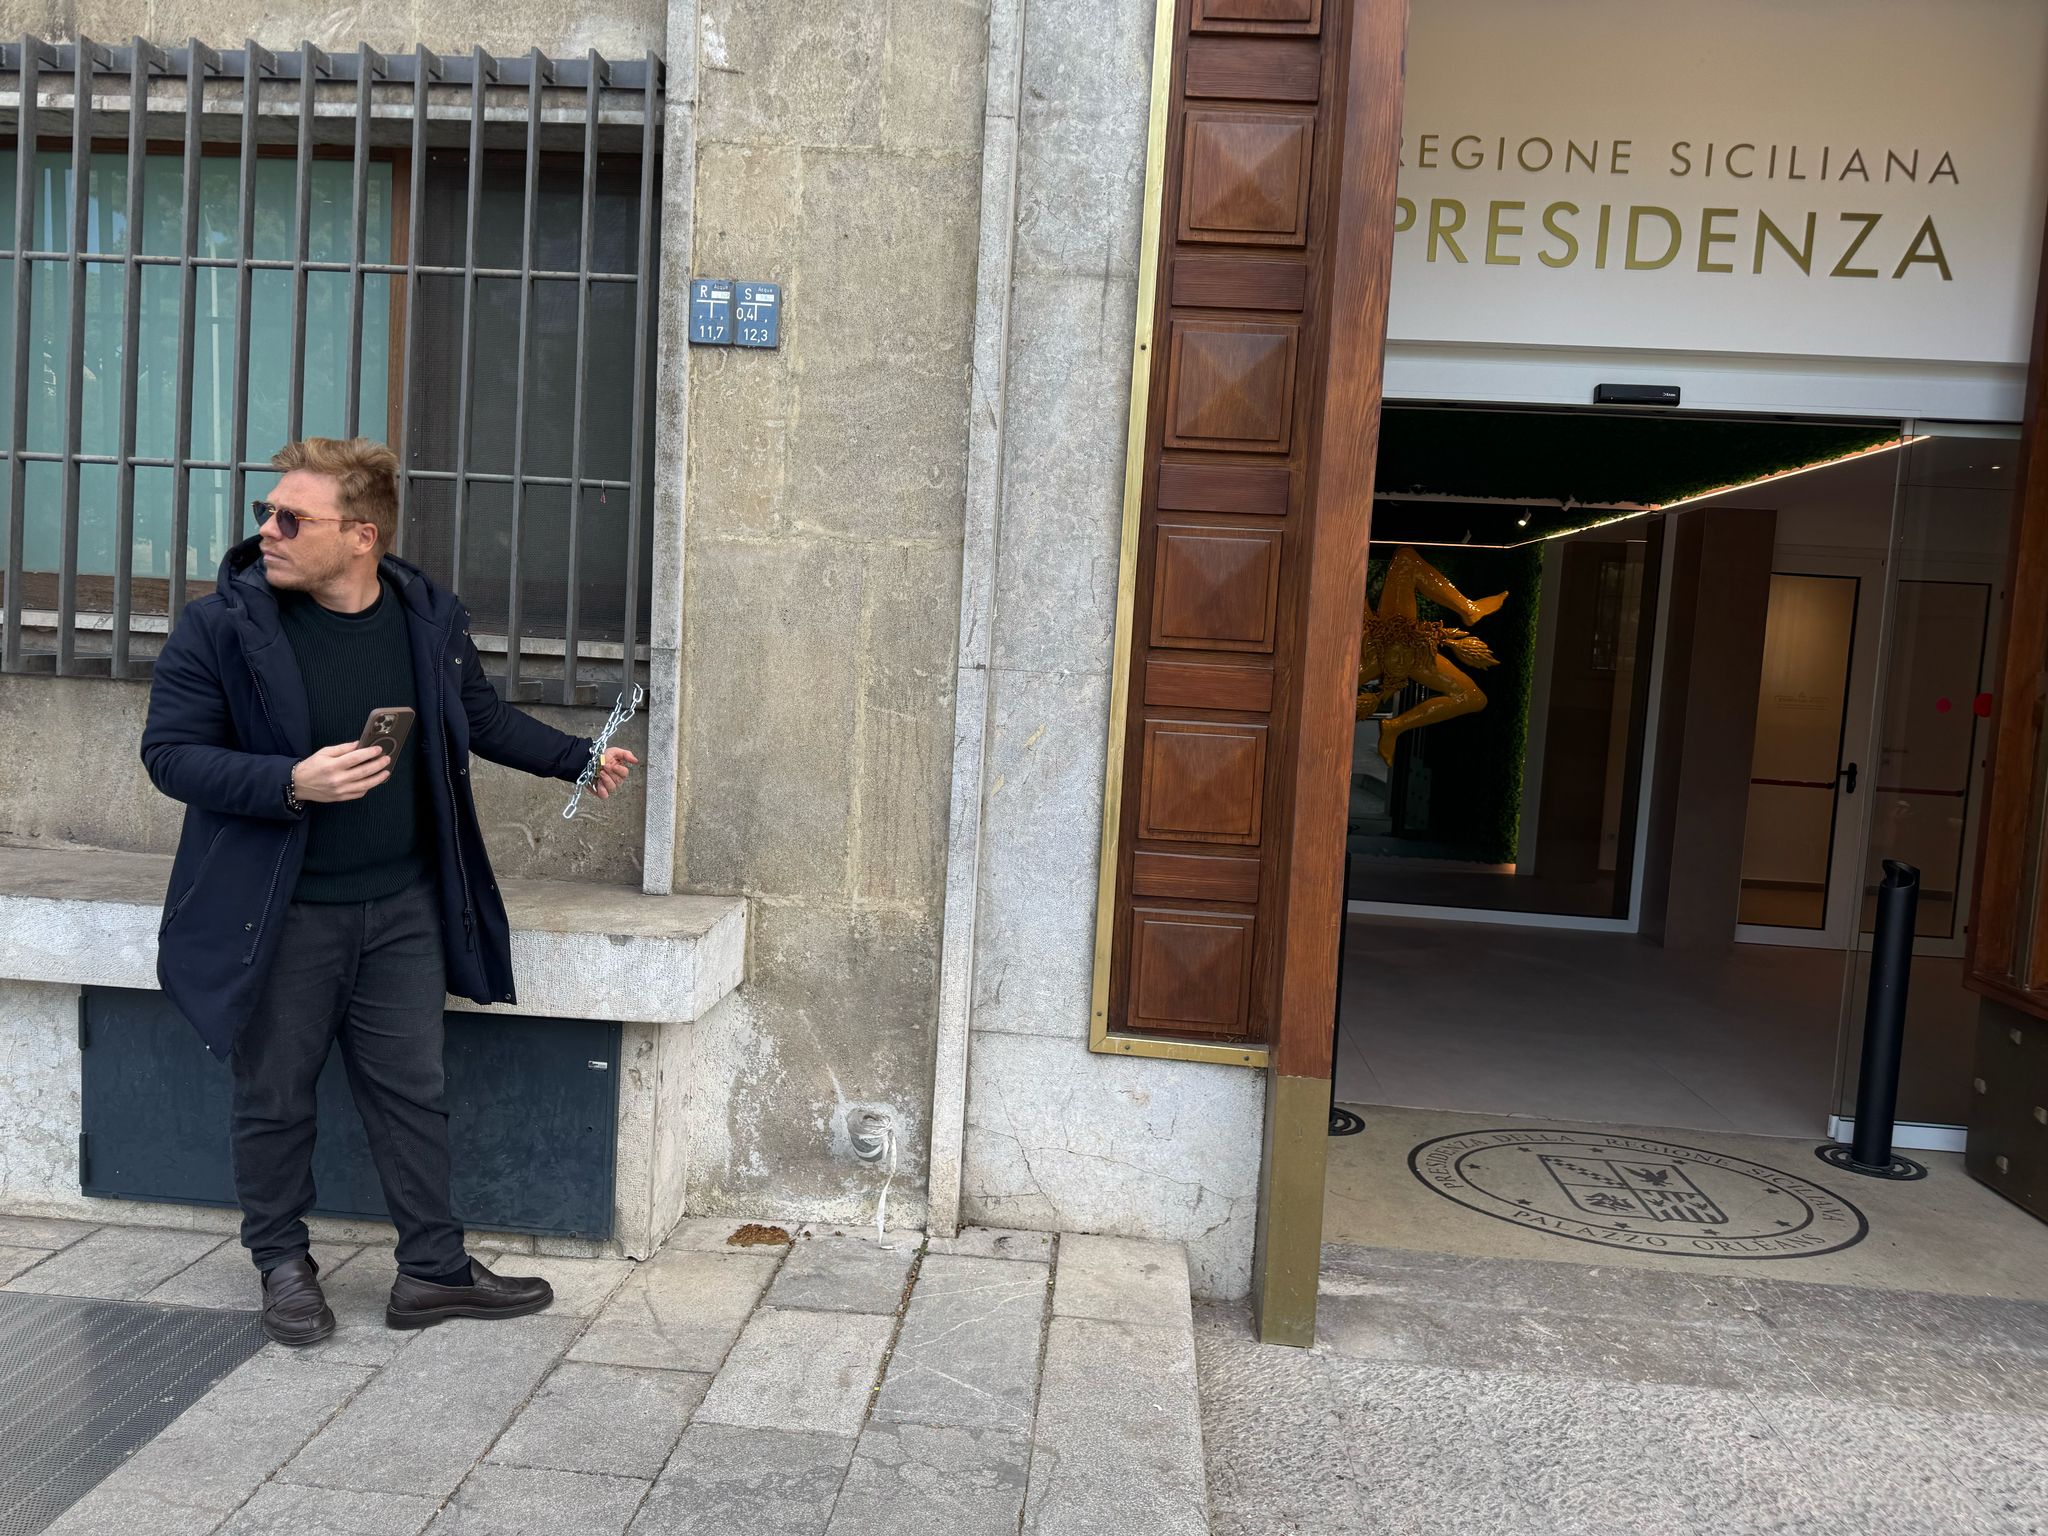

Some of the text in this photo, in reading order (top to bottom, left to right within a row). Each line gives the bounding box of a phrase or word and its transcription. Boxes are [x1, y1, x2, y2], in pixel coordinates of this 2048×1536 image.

[1400, 134, 1961, 185] EGIONE SICILIANA
[1395, 196, 1954, 282] PRESIDENZA
[700, 285, 708, 298] R
[744, 288, 752, 300] S
[736, 307, 754, 322] 0,4
[699, 325, 724, 340] 11,7
[743, 328, 768, 343] 12,3
[1425, 1133, 1845, 1223] PRESIDENZA DELLA REGIONE SICILIANA
[1512, 1210, 1669, 1247] PALAZZO
